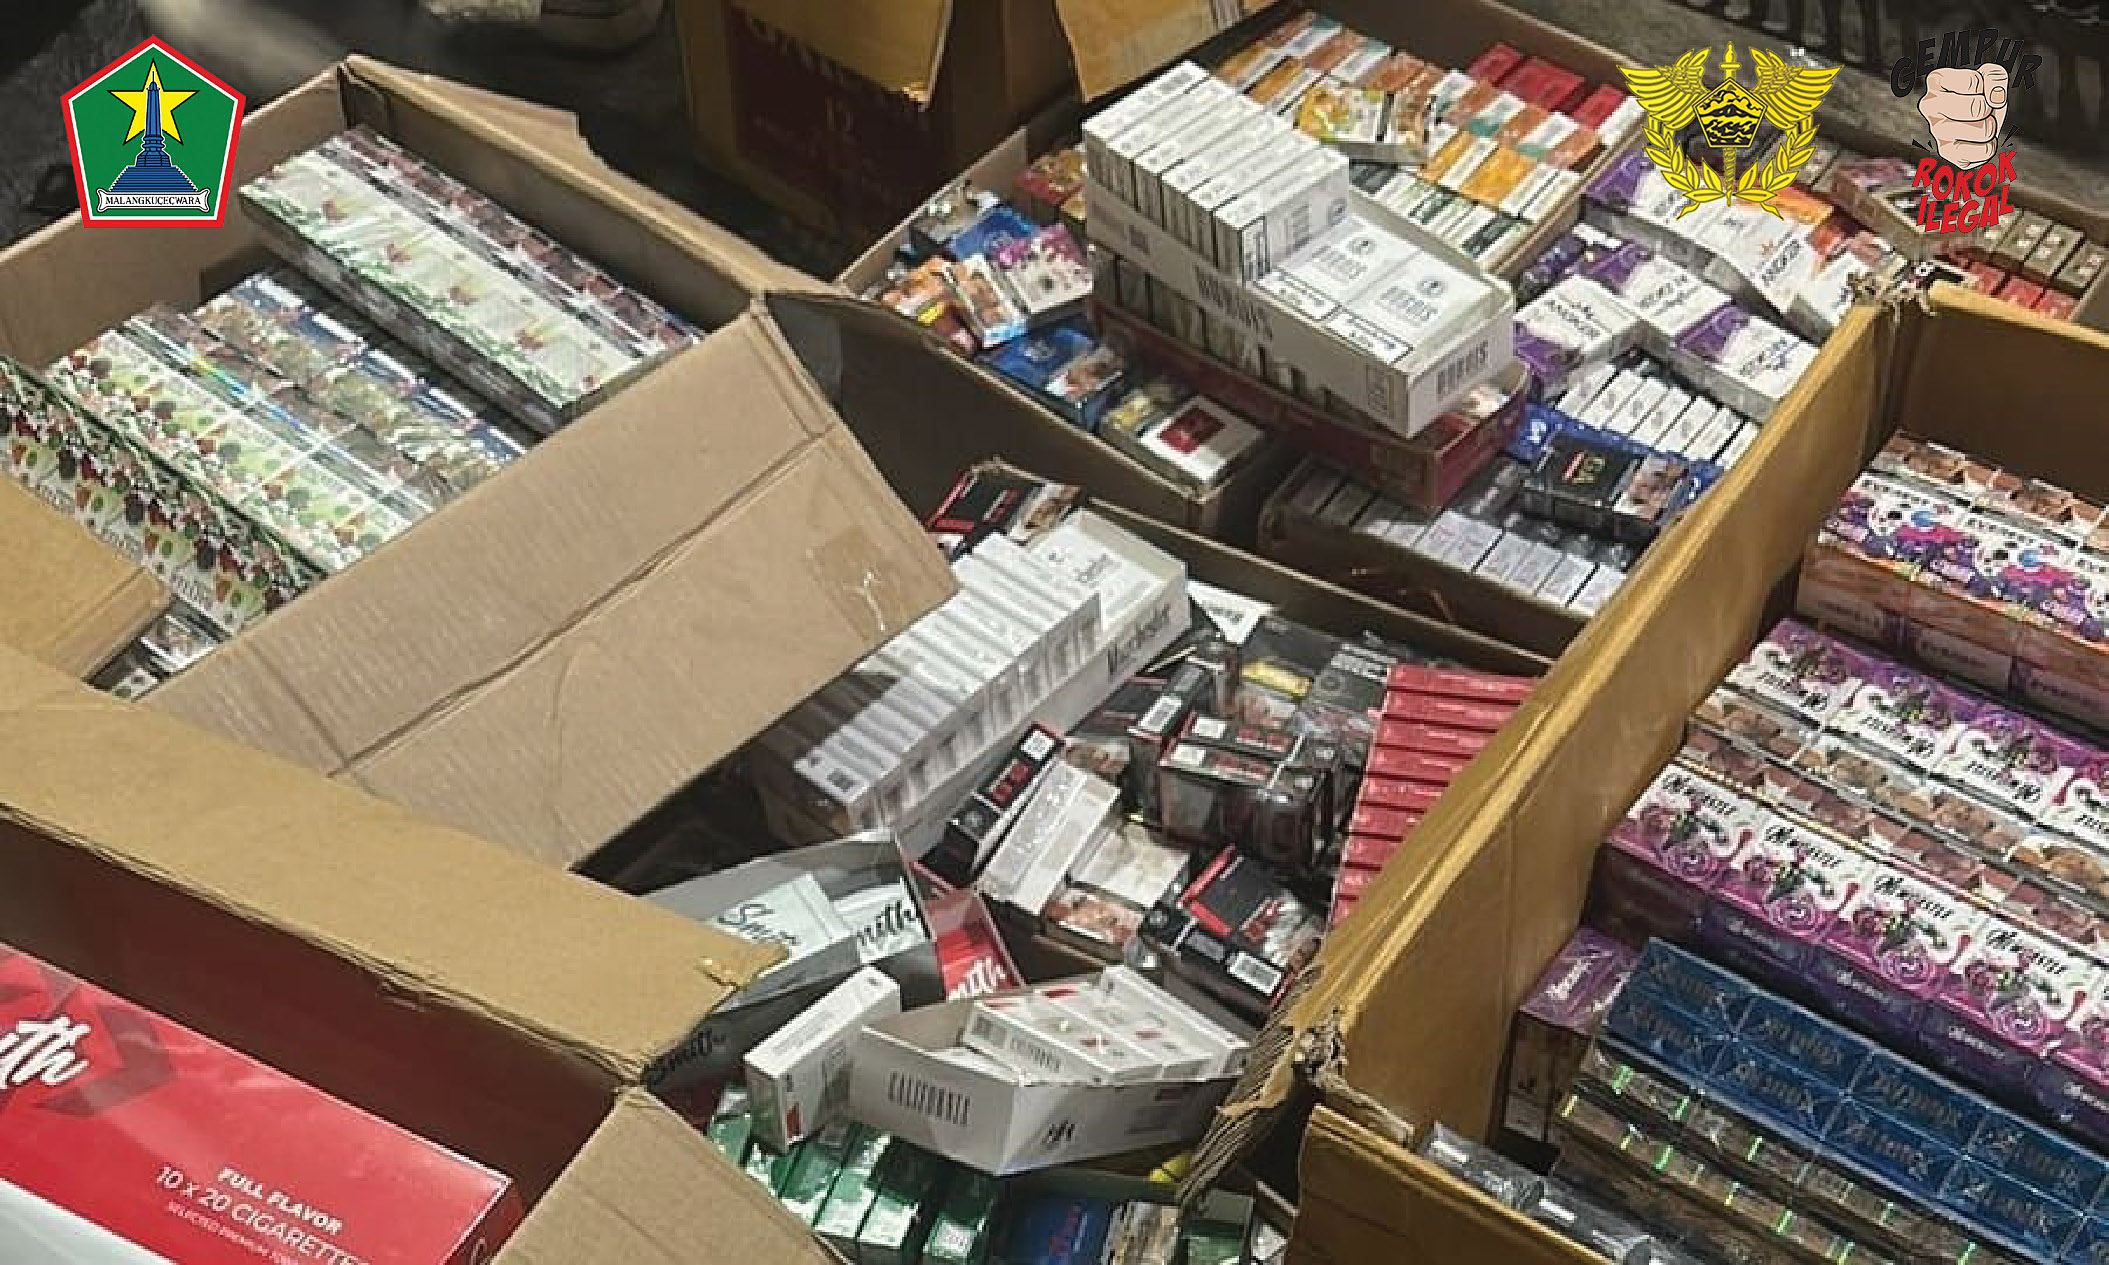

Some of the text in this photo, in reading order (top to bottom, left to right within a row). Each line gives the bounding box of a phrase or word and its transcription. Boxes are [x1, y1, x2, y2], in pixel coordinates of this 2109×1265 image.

[887, 1072, 970, 1127] CALIFORNIA
[156, 1166, 184, 1190] 10
[198, 1187, 232, 1213] 20
[231, 1203, 371, 1265] CIGARETTE
[218, 1167, 343, 1236] FULL FLAVOR
